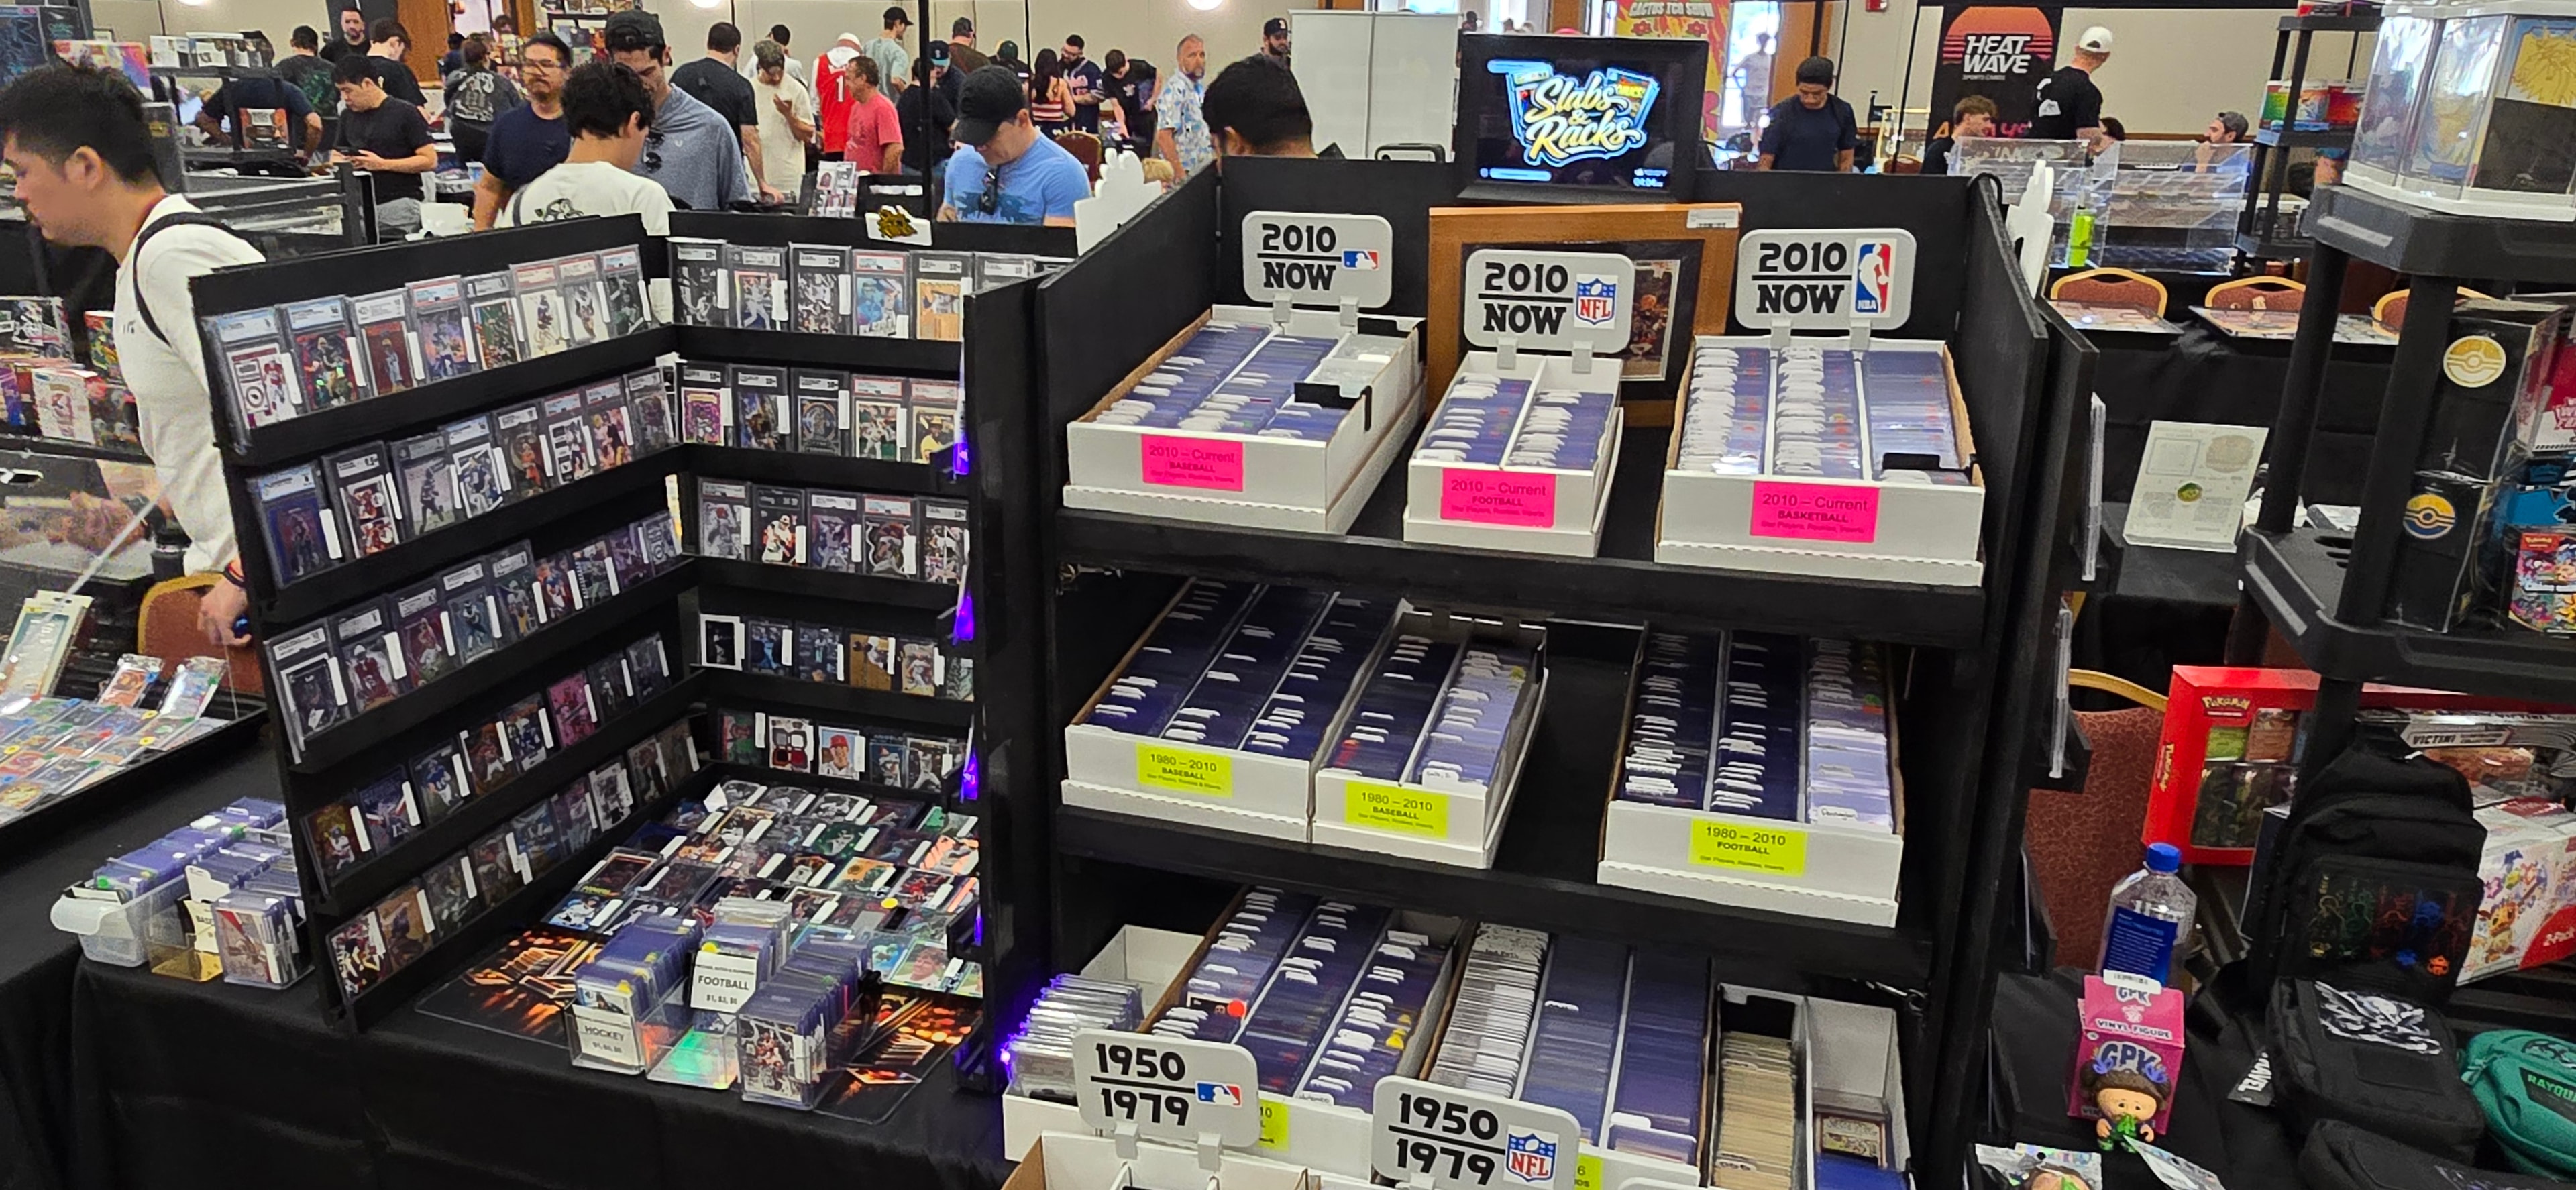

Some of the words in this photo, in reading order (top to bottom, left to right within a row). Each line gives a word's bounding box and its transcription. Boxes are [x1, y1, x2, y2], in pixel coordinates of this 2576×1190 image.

[1629, 2, 1664, 16] CACTUS
[1686, 2, 1715, 17] SHOW
[1967, 36, 2031, 54] HEAT
[1964, 54, 2031, 74] WAVE
[1524, 74, 1628, 123] Slabs
[1568, 110, 1591, 125] &
[1525, 109, 1642, 160] Racks
[1262, 223, 1336, 252] 2010
[1759, 242, 1847, 272] 2010
[1263, 262, 1336, 290] NOW
[1485, 262, 1568, 293] 2010
[1756, 284, 1845, 313] NOW
[1858, 299, 1876, 309] NBA
[1580, 299, 1611, 319] NFL
[1483, 303, 1566, 335] NOW
[1149, 445, 1179, 457] 2010
[1191, 449, 1234, 463] Current
[1170, 462, 1215, 473] BASEBALL
[1452, 479, 1483, 492] 2010
[1499, 482, 1546, 496] Current
[1472, 496, 1523, 506] FOOTBALL
[1763, 494, 1798, 506] 2010
[1815, 496, 1867, 511] Current
[1778, 510, 1848, 523] BASKETBALL
[2413, 734, 2456, 744] VICTINI
[1151, 753, 1177, 765] 1980
[1189, 759, 1217, 772] 2010
[1162, 767, 1205, 780] BASEBALL
[1362, 792, 1389, 804] 1980
[1403, 798, 1432, 811] 2010
[1373, 806, 1419, 820] BASEBALL
[1706, 826, 1737, 839] 1980
[1753, 832, 1786, 846] 2010
[1717, 841, 1770, 855] FOOTBALL
[698, 975, 749, 990] FOOTBALL
[585, 1026, 624, 1040] HOCKEY
[2098, 1020, 2128, 1032] VINYL
[2133, 1026, 2170, 1038] FIGURE
[1095, 1043, 1185, 1081] 1950
[1101, 1088, 1189, 1126] 1979
[1399, 1093, 1498, 1140] 1950
[1396, 1138, 1495, 1185] 1979
[1511, 1152, 1549, 1177] NFL
